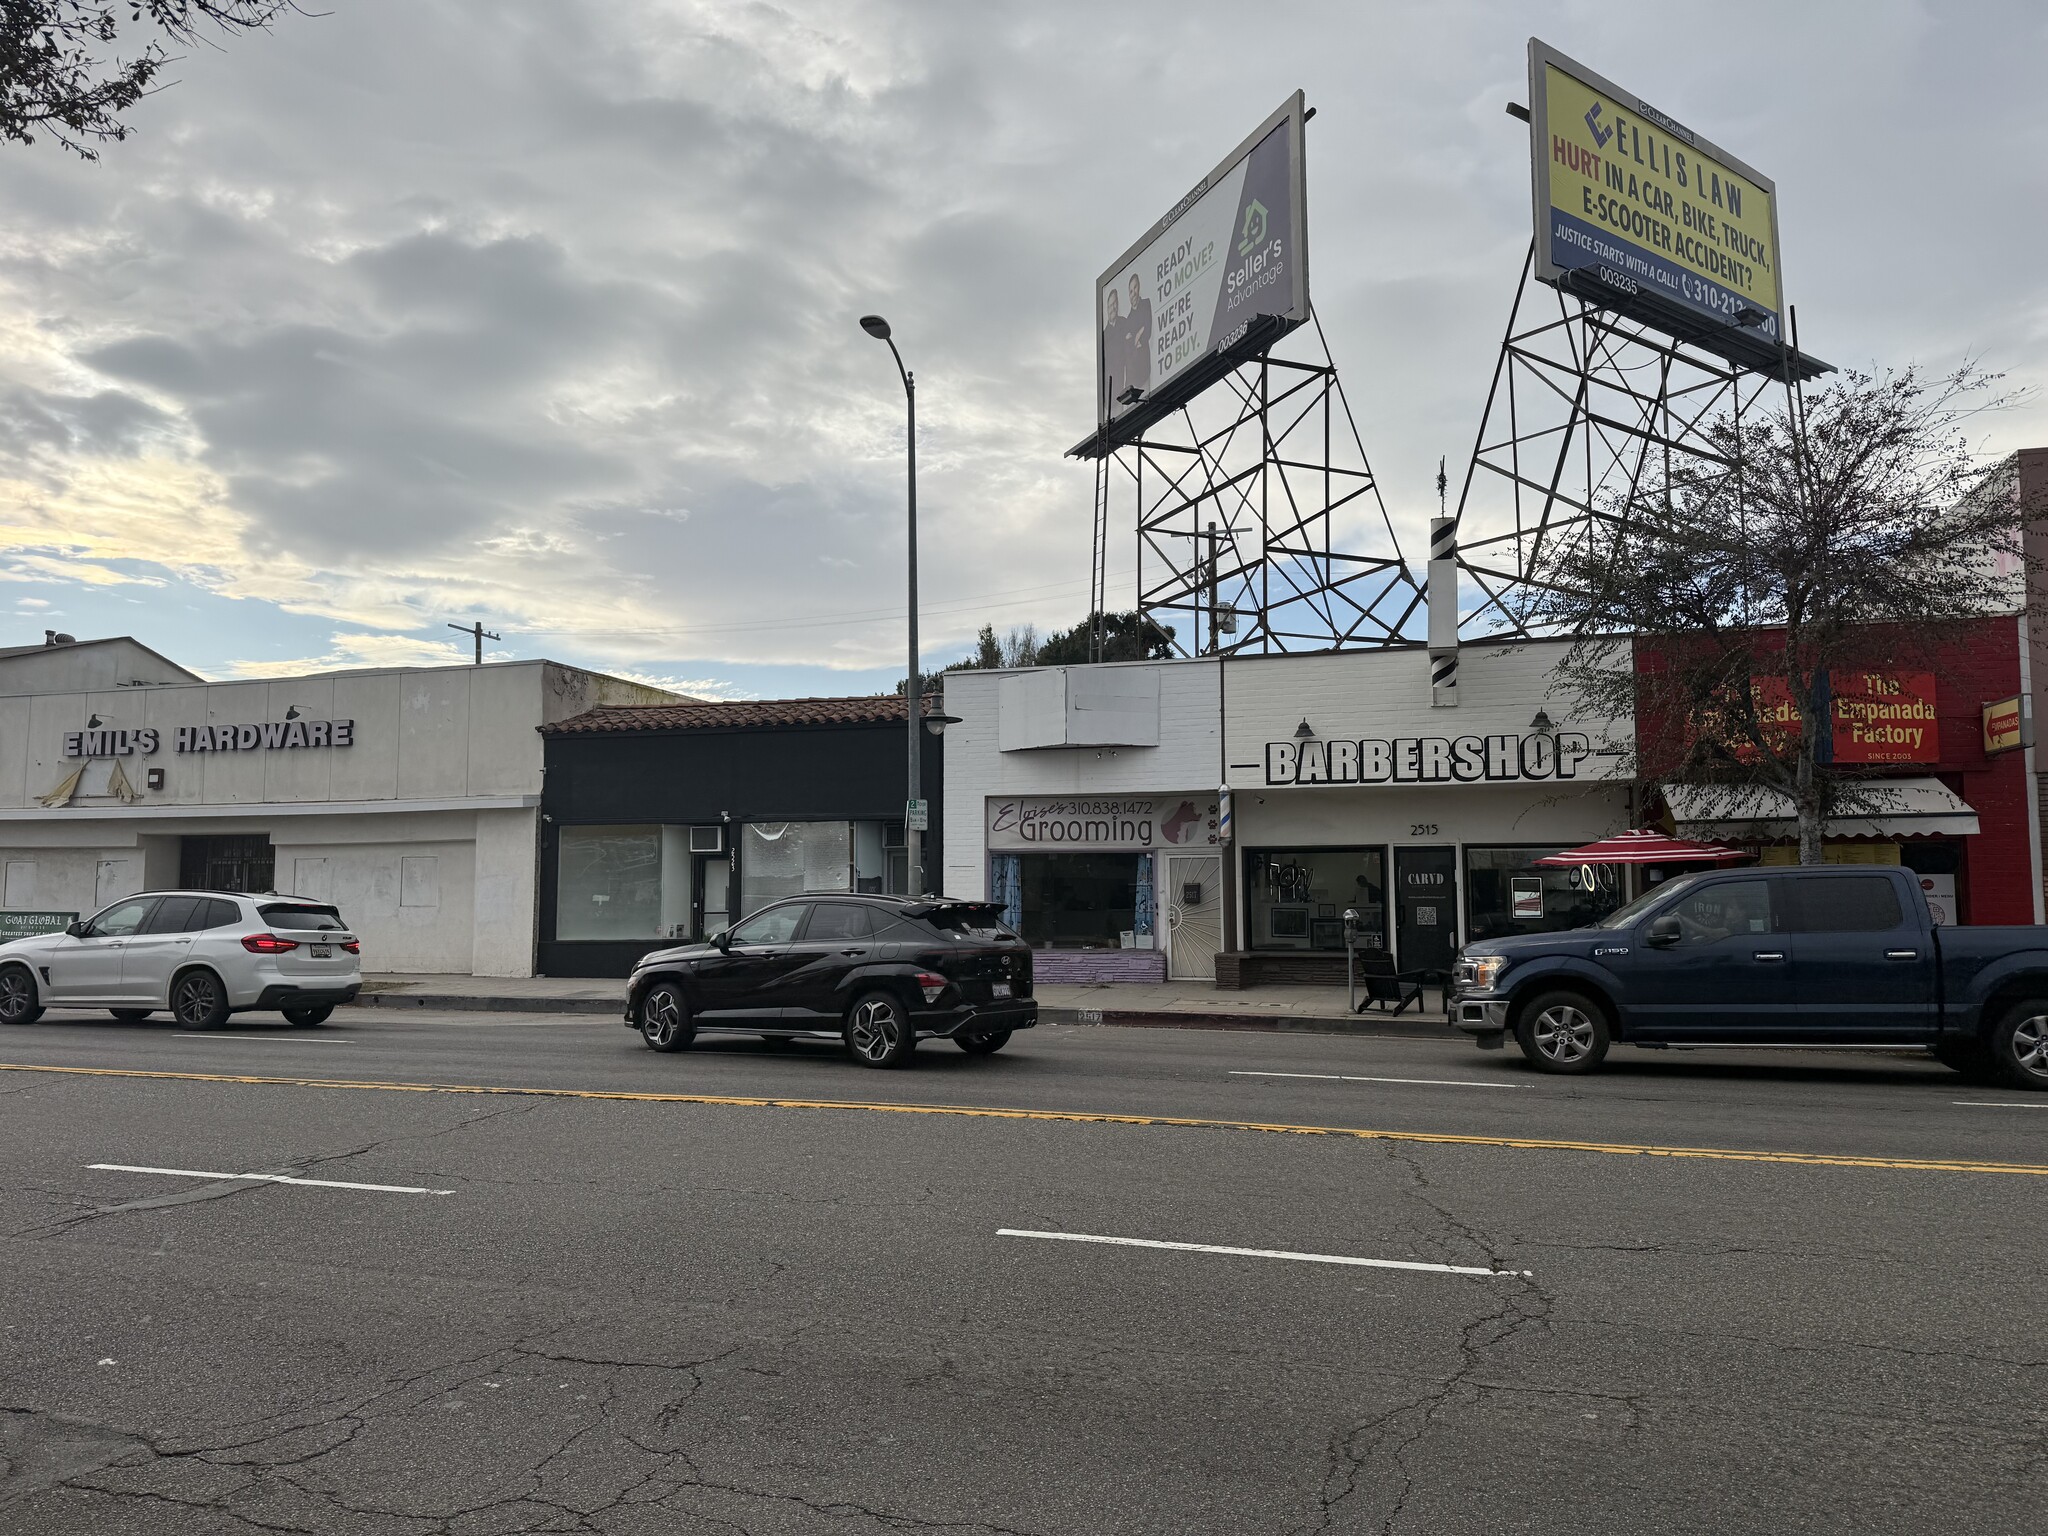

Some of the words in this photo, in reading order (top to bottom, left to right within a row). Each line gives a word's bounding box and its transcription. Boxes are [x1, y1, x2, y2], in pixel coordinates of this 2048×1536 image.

[1616, 116, 1687, 188] ELLIS
[1697, 164, 1741, 219] LAW
[1553, 134, 1601, 182] HURT
[1605, 160, 1623, 194] IN
[1628, 173, 1639, 201] A
[1643, 181, 1678, 225] CAR,
[1682, 200, 1720, 246] BIKE,
[1722, 222, 1770, 273] TRUCK,
[1555, 224, 1592, 251] JUSTICE
[1593, 241, 1625, 266] STARTS
[1626, 254, 1648, 276] WITH
[1649, 265, 1655, 280] A
[1657, 269, 1679, 289] CALL!
[1583, 185, 1671, 252] E-SCOOTER
[1675, 231, 1752, 291] ACCIDENT?
[1157, 236, 1193, 282] READY
[1157, 279, 1172, 302] TO
[1174, 240, 1214, 289] MOVE?
[1227, 239, 1282, 293] Seller's
[1227, 261, 1284, 312] Advantage
[1600, 266, 1638, 295] 003235
[1158, 291, 1191, 332] WE'RE
[1158, 312, 1194, 355] READY
[1218, 320, 1249, 353] 003236
[1158, 352, 1173, 375] TO
[1175, 331, 1200, 364] BUY.
[1863, 674, 1900, 696] The
[1838, 699, 1935, 725] Empanada
[1991, 716, 2019, 732] EMPANADAS
[63, 728, 160, 756] EMIL'S
[173, 719, 355, 752] HARDWARE
[1853, 723, 1924, 749] Factory
[1265, 733, 1590, 785] BARBERSHOP
[1867, 752, 1890, 760] SINCE
[992, 800, 1070, 831] Eloise's
[1068, 801, 1153, 815] 310.838.1472
[1019, 815, 1153, 846] Grooming
[1411, 824, 1438, 836] 2515
[1407, 873, 1445, 885] CARVD
[29, 915, 61, 925] GLOBAL
